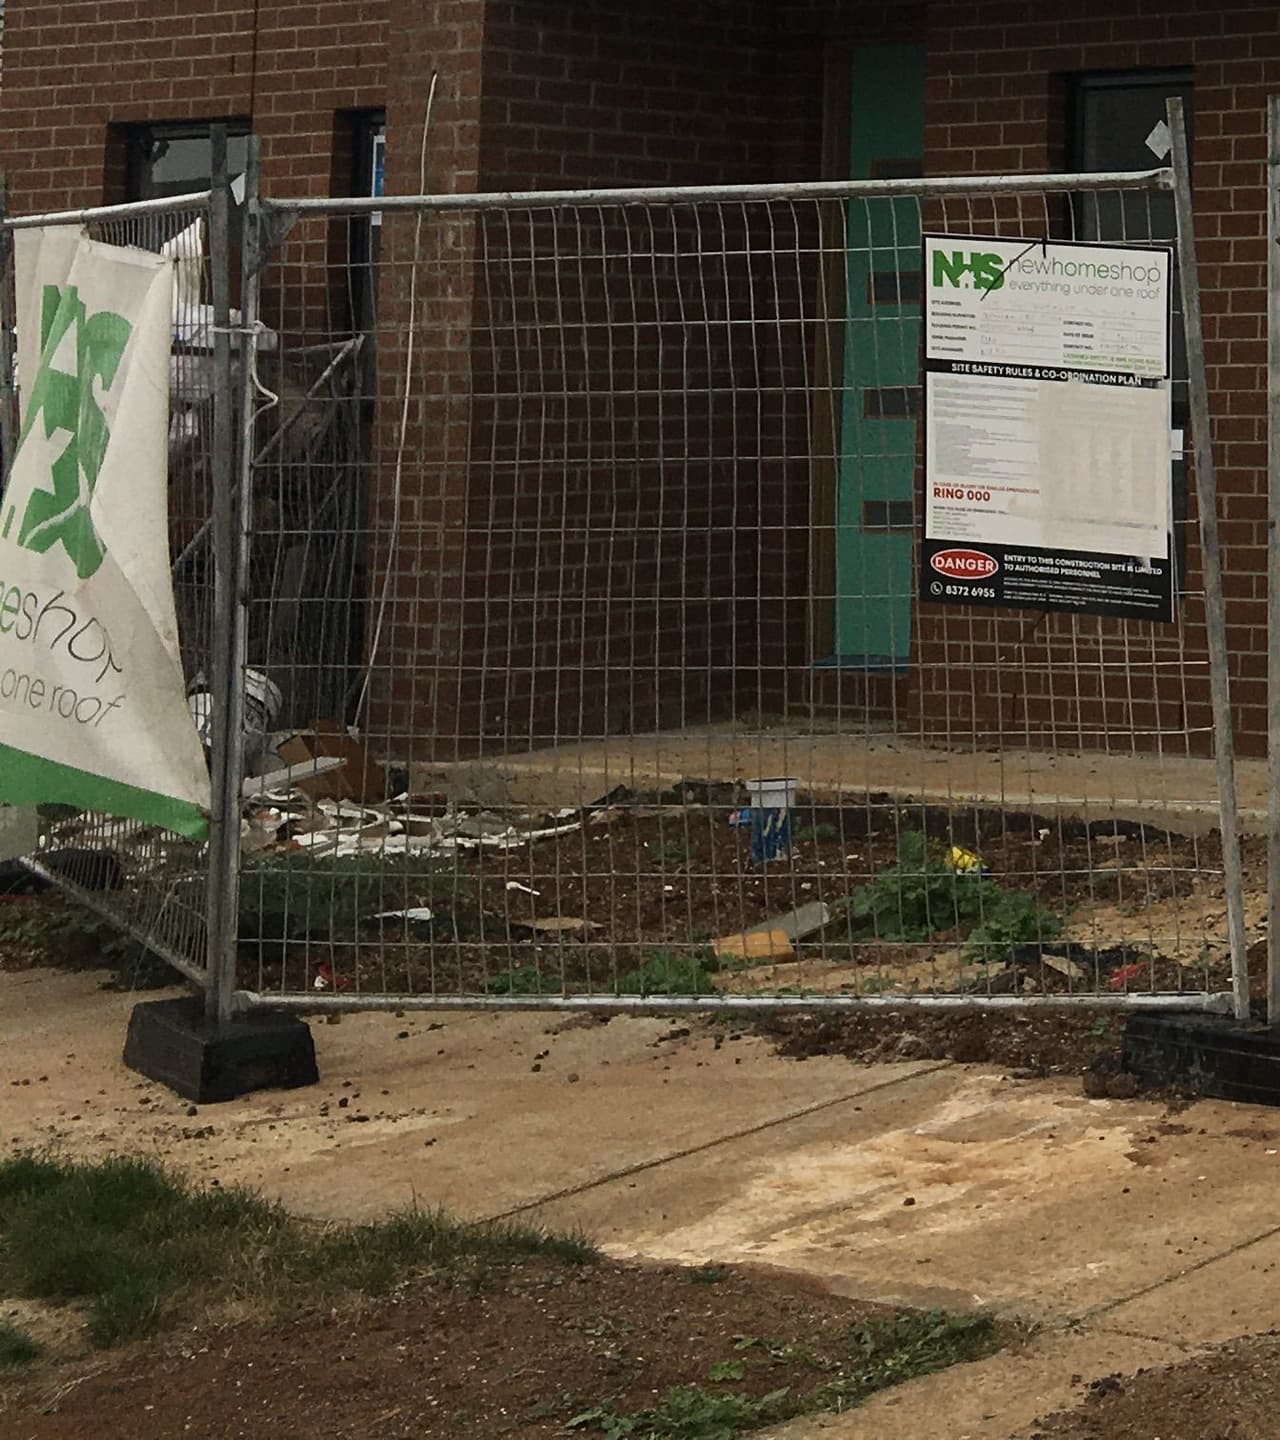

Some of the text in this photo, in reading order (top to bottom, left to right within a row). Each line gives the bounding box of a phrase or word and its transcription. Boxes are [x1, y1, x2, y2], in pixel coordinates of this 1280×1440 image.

[932, 249, 1005, 290] NHS
[1009, 257, 1161, 286] newhomeshop
[1009, 279, 1070, 296] everything
[1110, 287, 1133, 297] one
[1137, 288, 1160, 299] roof
[951, 363, 1141, 386] SITE SAFETY RULES & CO-ORDINATION PLAN
[933, 487, 964, 500] RING
[967, 490, 991, 501] 000
[934, 556, 995, 572] DANGER
[1004, 554, 1025, 563] ENTRY
[1028, 555, 1037, 564] TO
[1038, 556, 1054, 565] THIS
[1055, 558, 1110, 570] CONSTRUCTION
[1112, 563, 1126, 572] SITE
[1135, 565, 1163, 575] LIMTED
[1004, 563, 1014, 571] TO
[1060, 567, 1101, 578] PERSONNEL
[945, 585, 969, 596] 8372
[971, 586, 995, 598] 6955
[1, 669, 126, 727] one roof
